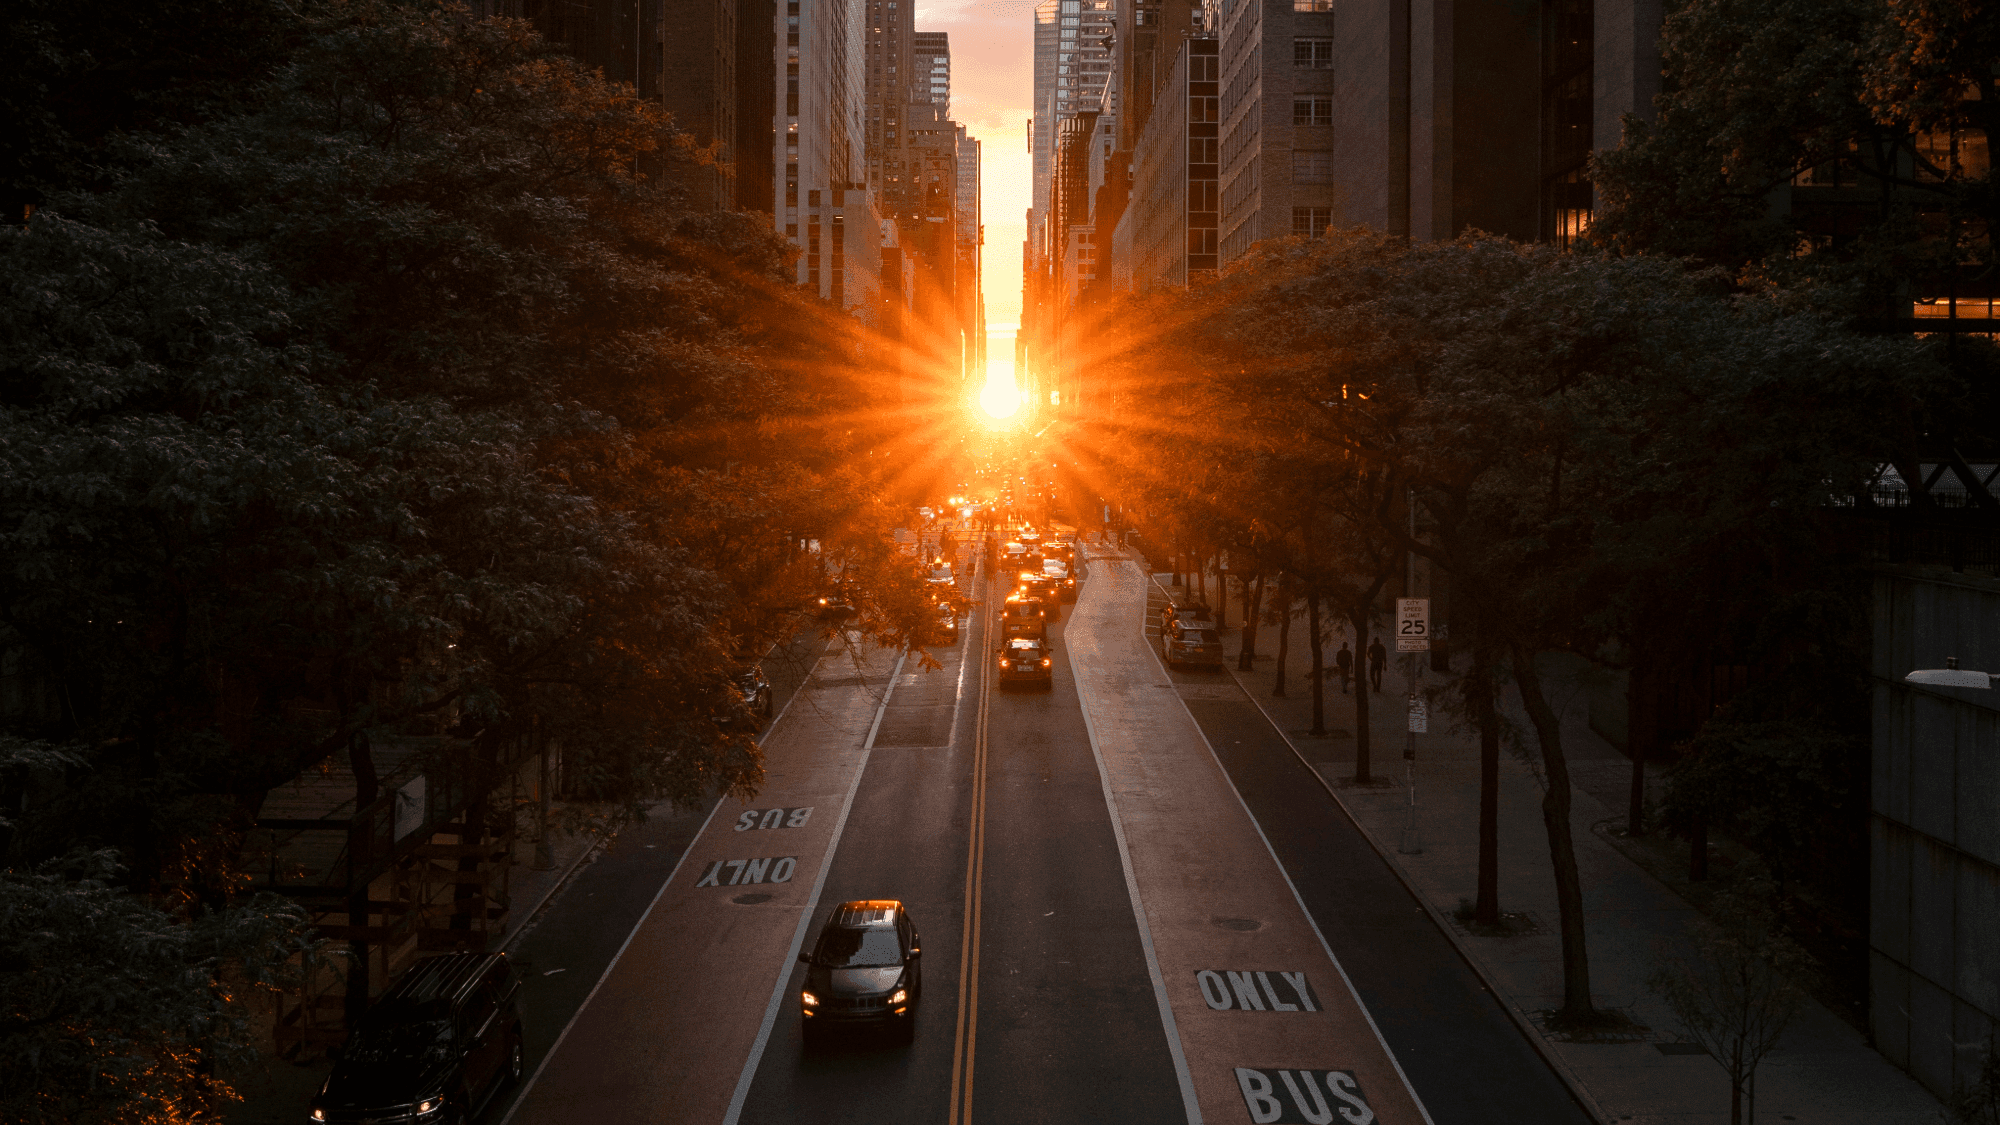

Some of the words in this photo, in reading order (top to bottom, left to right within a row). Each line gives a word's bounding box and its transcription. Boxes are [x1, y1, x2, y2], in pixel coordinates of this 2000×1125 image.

[1401, 620, 1425, 634] 25
[734, 807, 815, 831] BUS
[696, 857, 797, 888] ONLY
[1196, 970, 1317, 1012] ONLY
[1234, 1067, 1375, 1125] BUS
